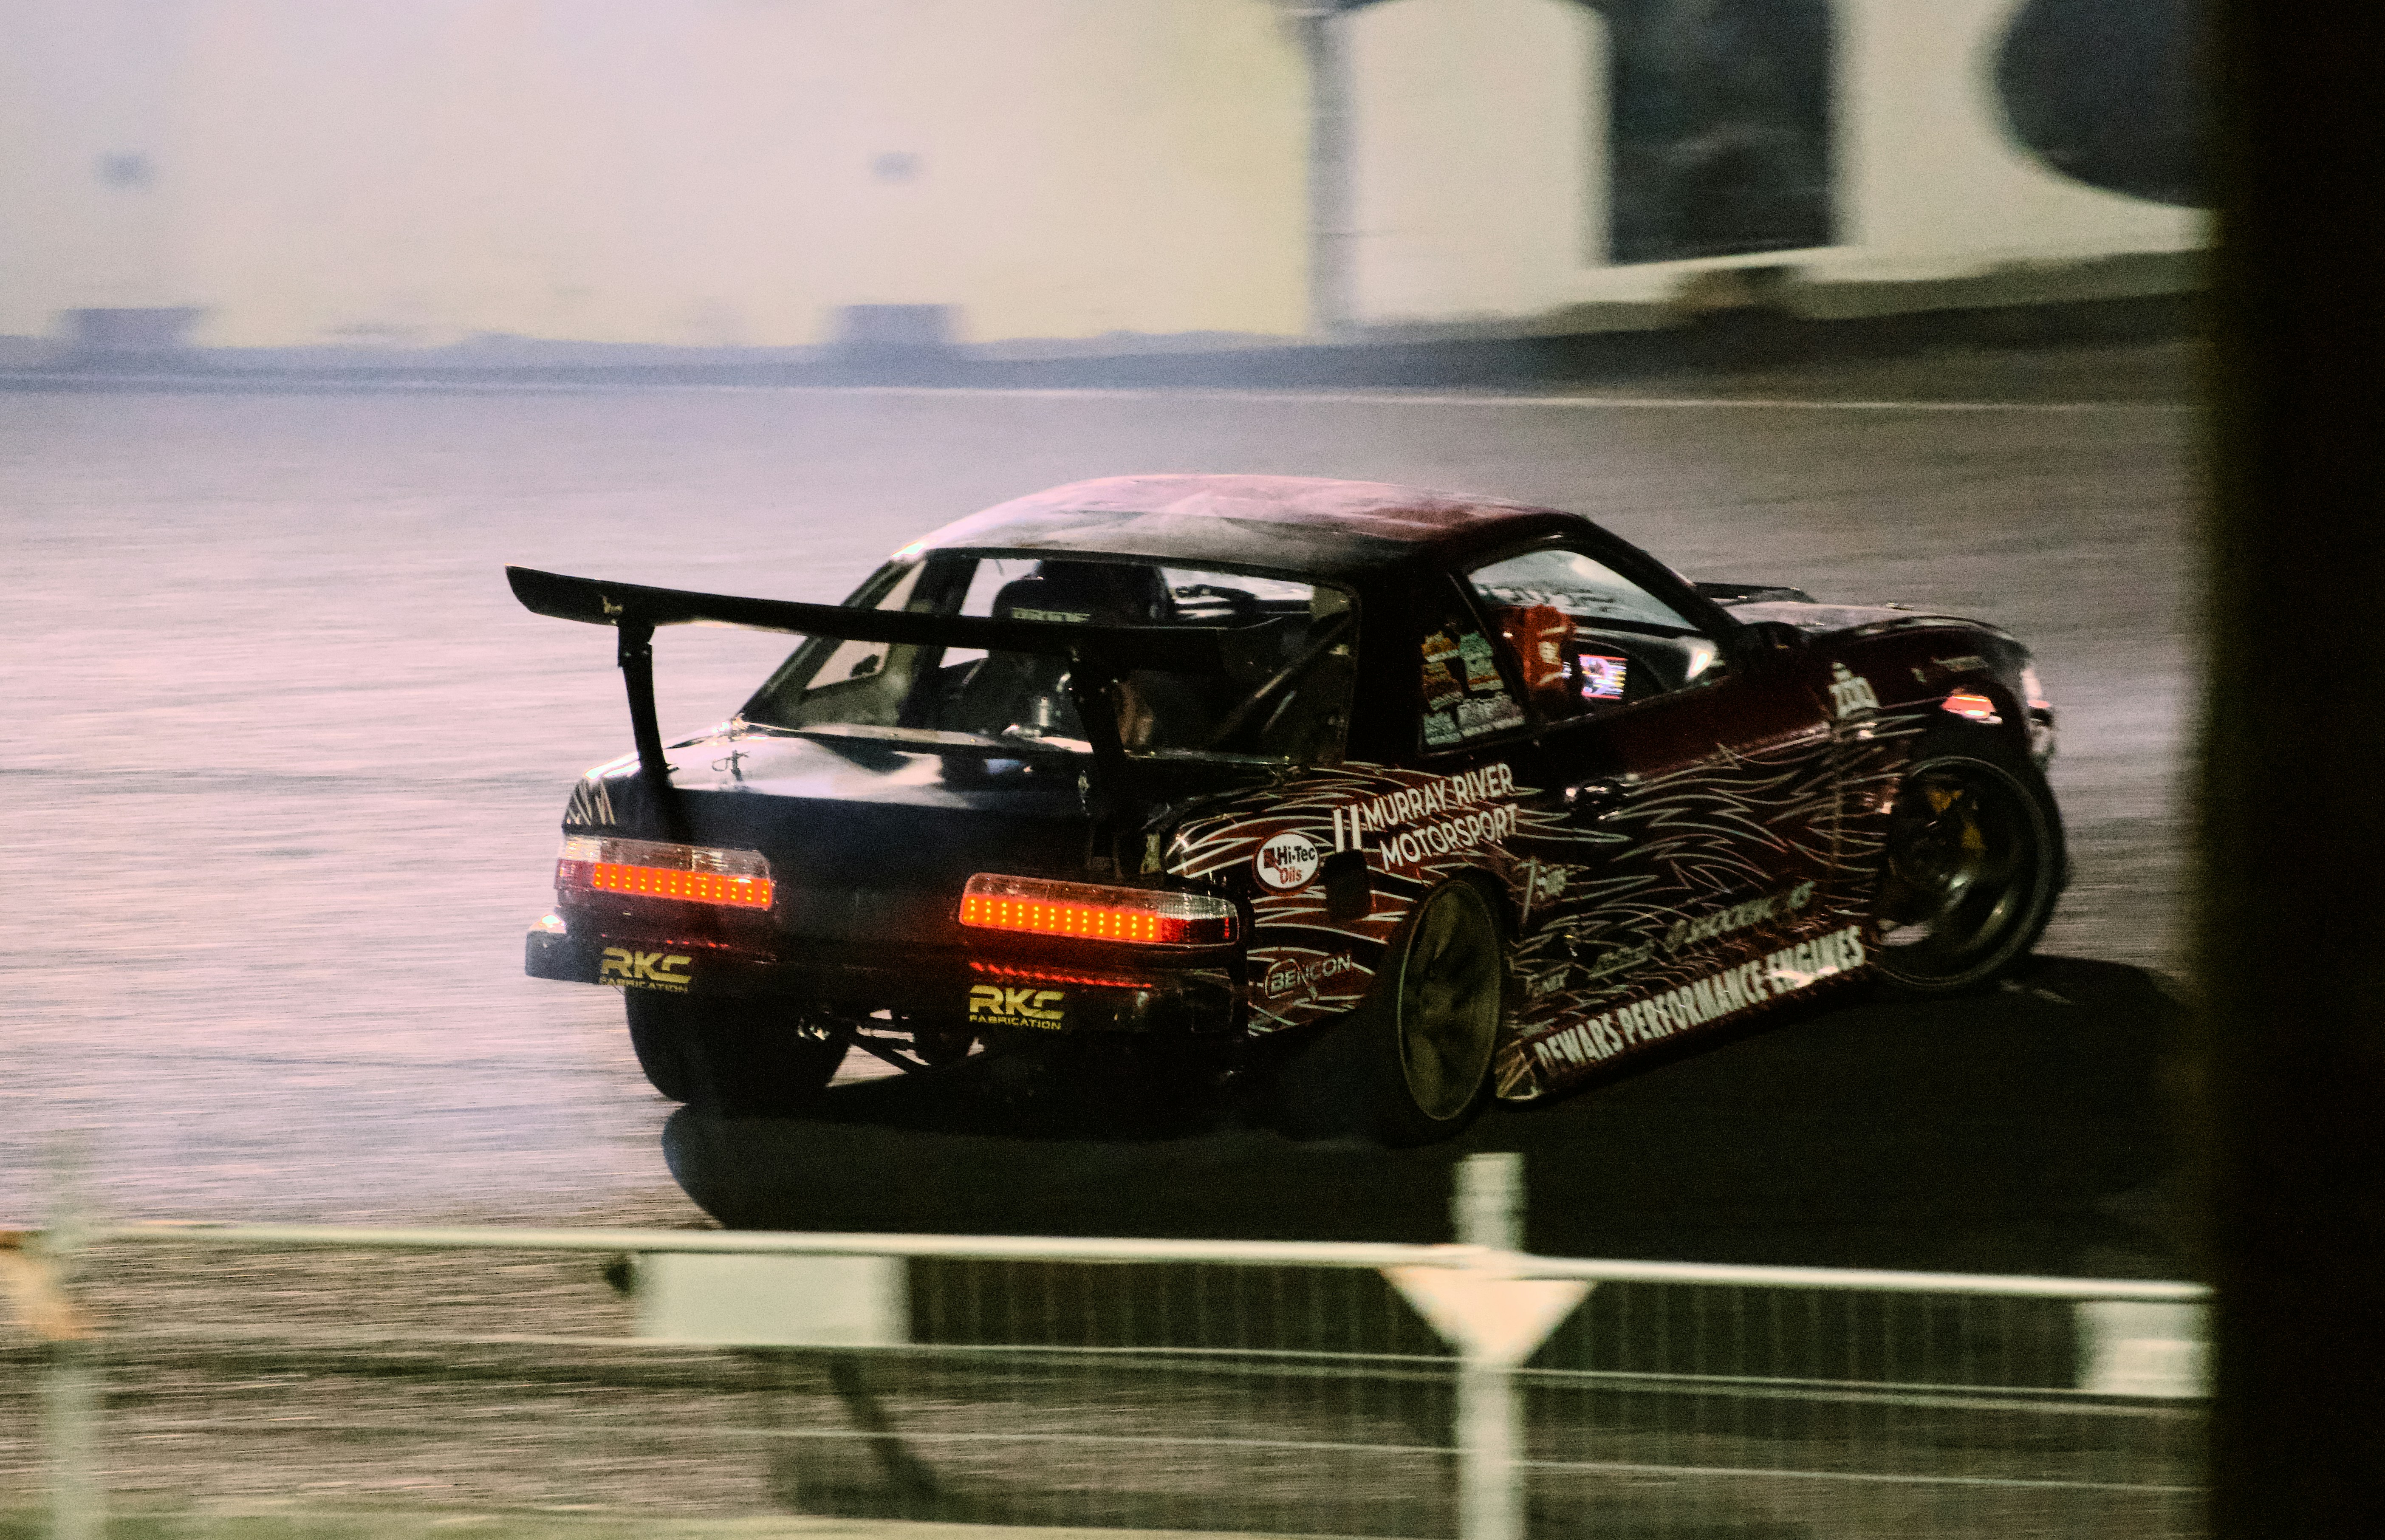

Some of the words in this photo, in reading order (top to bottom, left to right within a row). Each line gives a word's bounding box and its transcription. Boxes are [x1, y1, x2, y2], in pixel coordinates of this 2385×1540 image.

[1361, 780, 1446, 831] MURRAY
[1451, 763, 1515, 805] RIVER
[1379, 803, 1518, 871] MOTORSPORT
[1277, 845, 1316, 865] Hi-Tec
[1280, 866, 1303, 884] Oils
[602, 947, 692, 983] RKC
[969, 985, 1064, 1020] RKC
[1616, 960, 1769, 1045] PERFORMANCE
[969, 1014, 1062, 1030] FABRICATION
